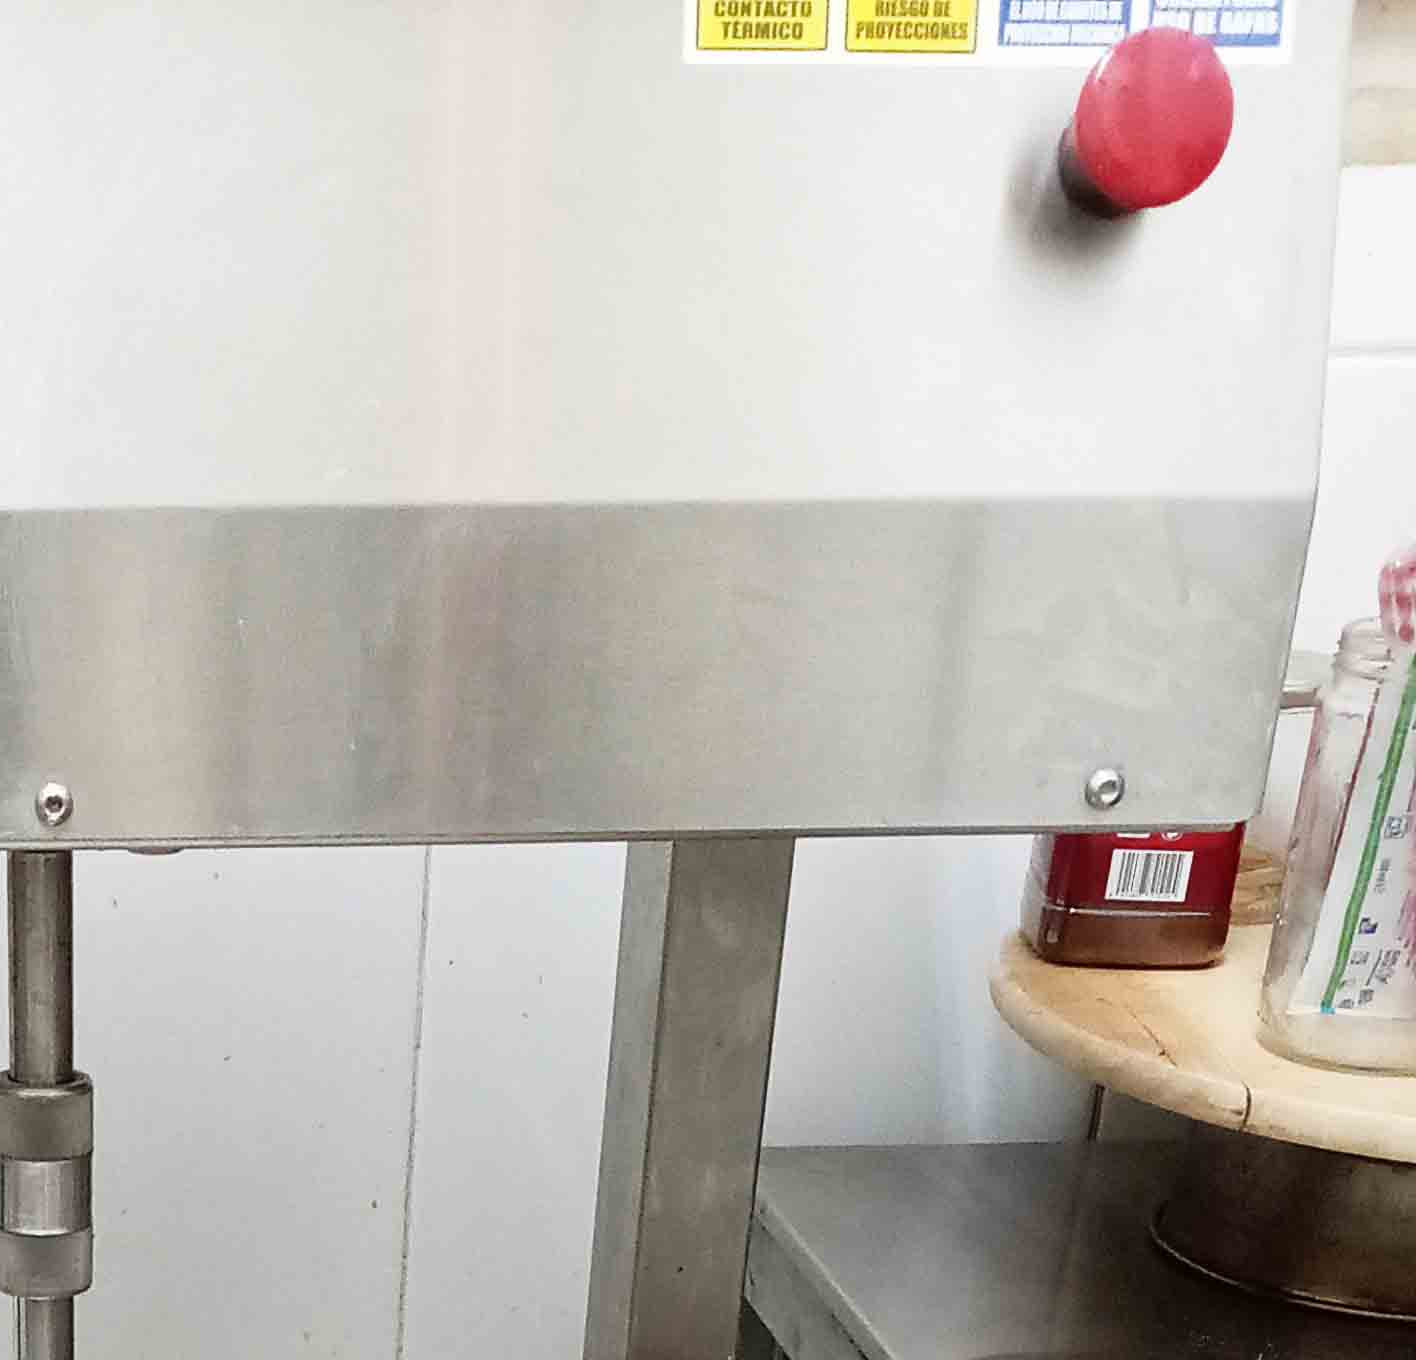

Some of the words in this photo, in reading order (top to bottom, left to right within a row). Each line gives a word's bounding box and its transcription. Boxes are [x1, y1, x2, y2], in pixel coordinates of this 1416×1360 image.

[714, 0, 813, 17] CONTACTO
[874, 0, 929, 17] RIESGO
[933, 0, 951, 17] DE
[855, 20, 969, 40] PROYECCIONES
